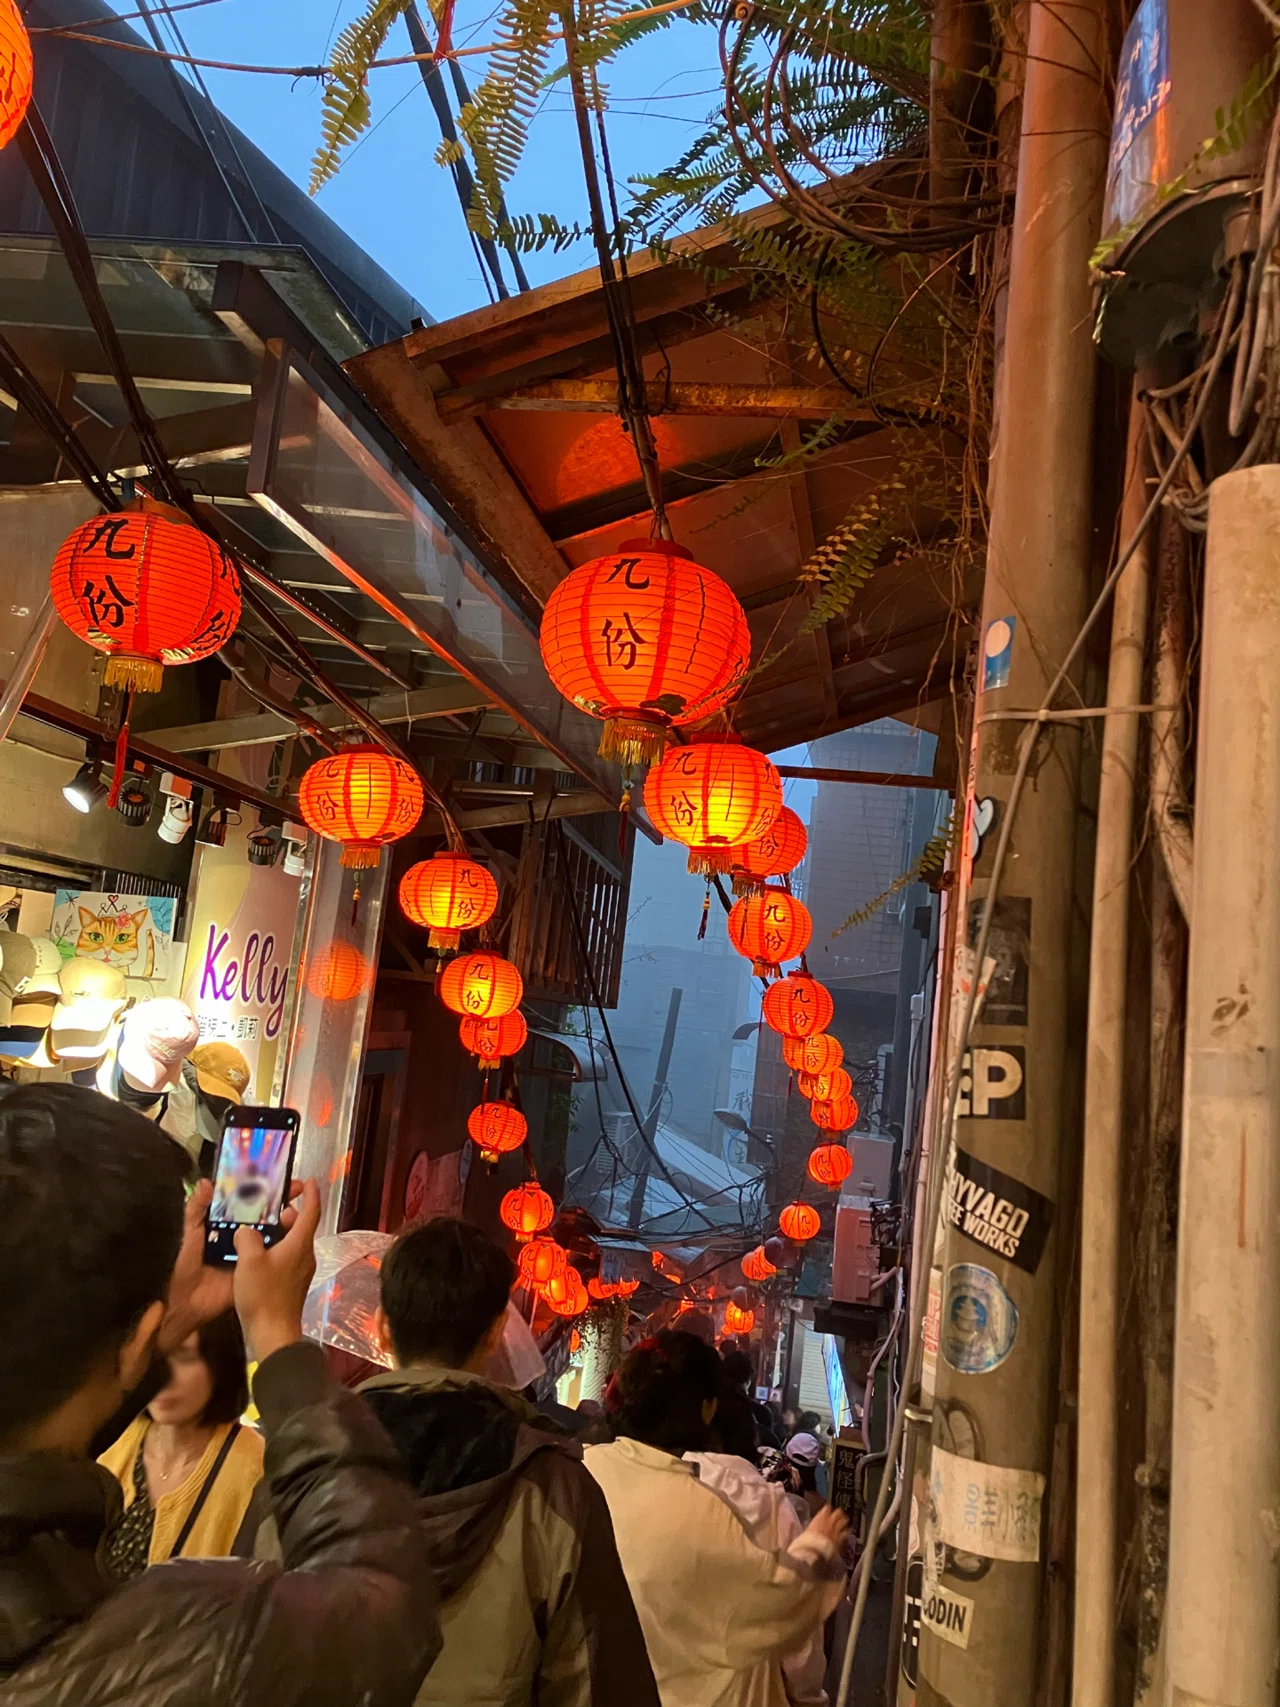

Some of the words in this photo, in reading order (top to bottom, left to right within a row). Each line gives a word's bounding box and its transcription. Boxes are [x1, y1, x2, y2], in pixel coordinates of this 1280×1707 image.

[83, 519, 135, 628] 九份
[601, 558, 650, 670] 九份
[317, 759, 340, 820] 九份
[395, 761, 415, 824] 九份
[670, 752, 698, 826] 九份
[458, 869, 478, 919] 九份
[764, 905, 786, 951] 九份
[200, 924, 289, 1037] Kelly
[466, 963, 489, 1009] 九份
[792, 989, 811, 1027] 九份
[948, 1172, 1030, 1239] HYVAGO
[963, 1211, 1020, 1257] WORKS
